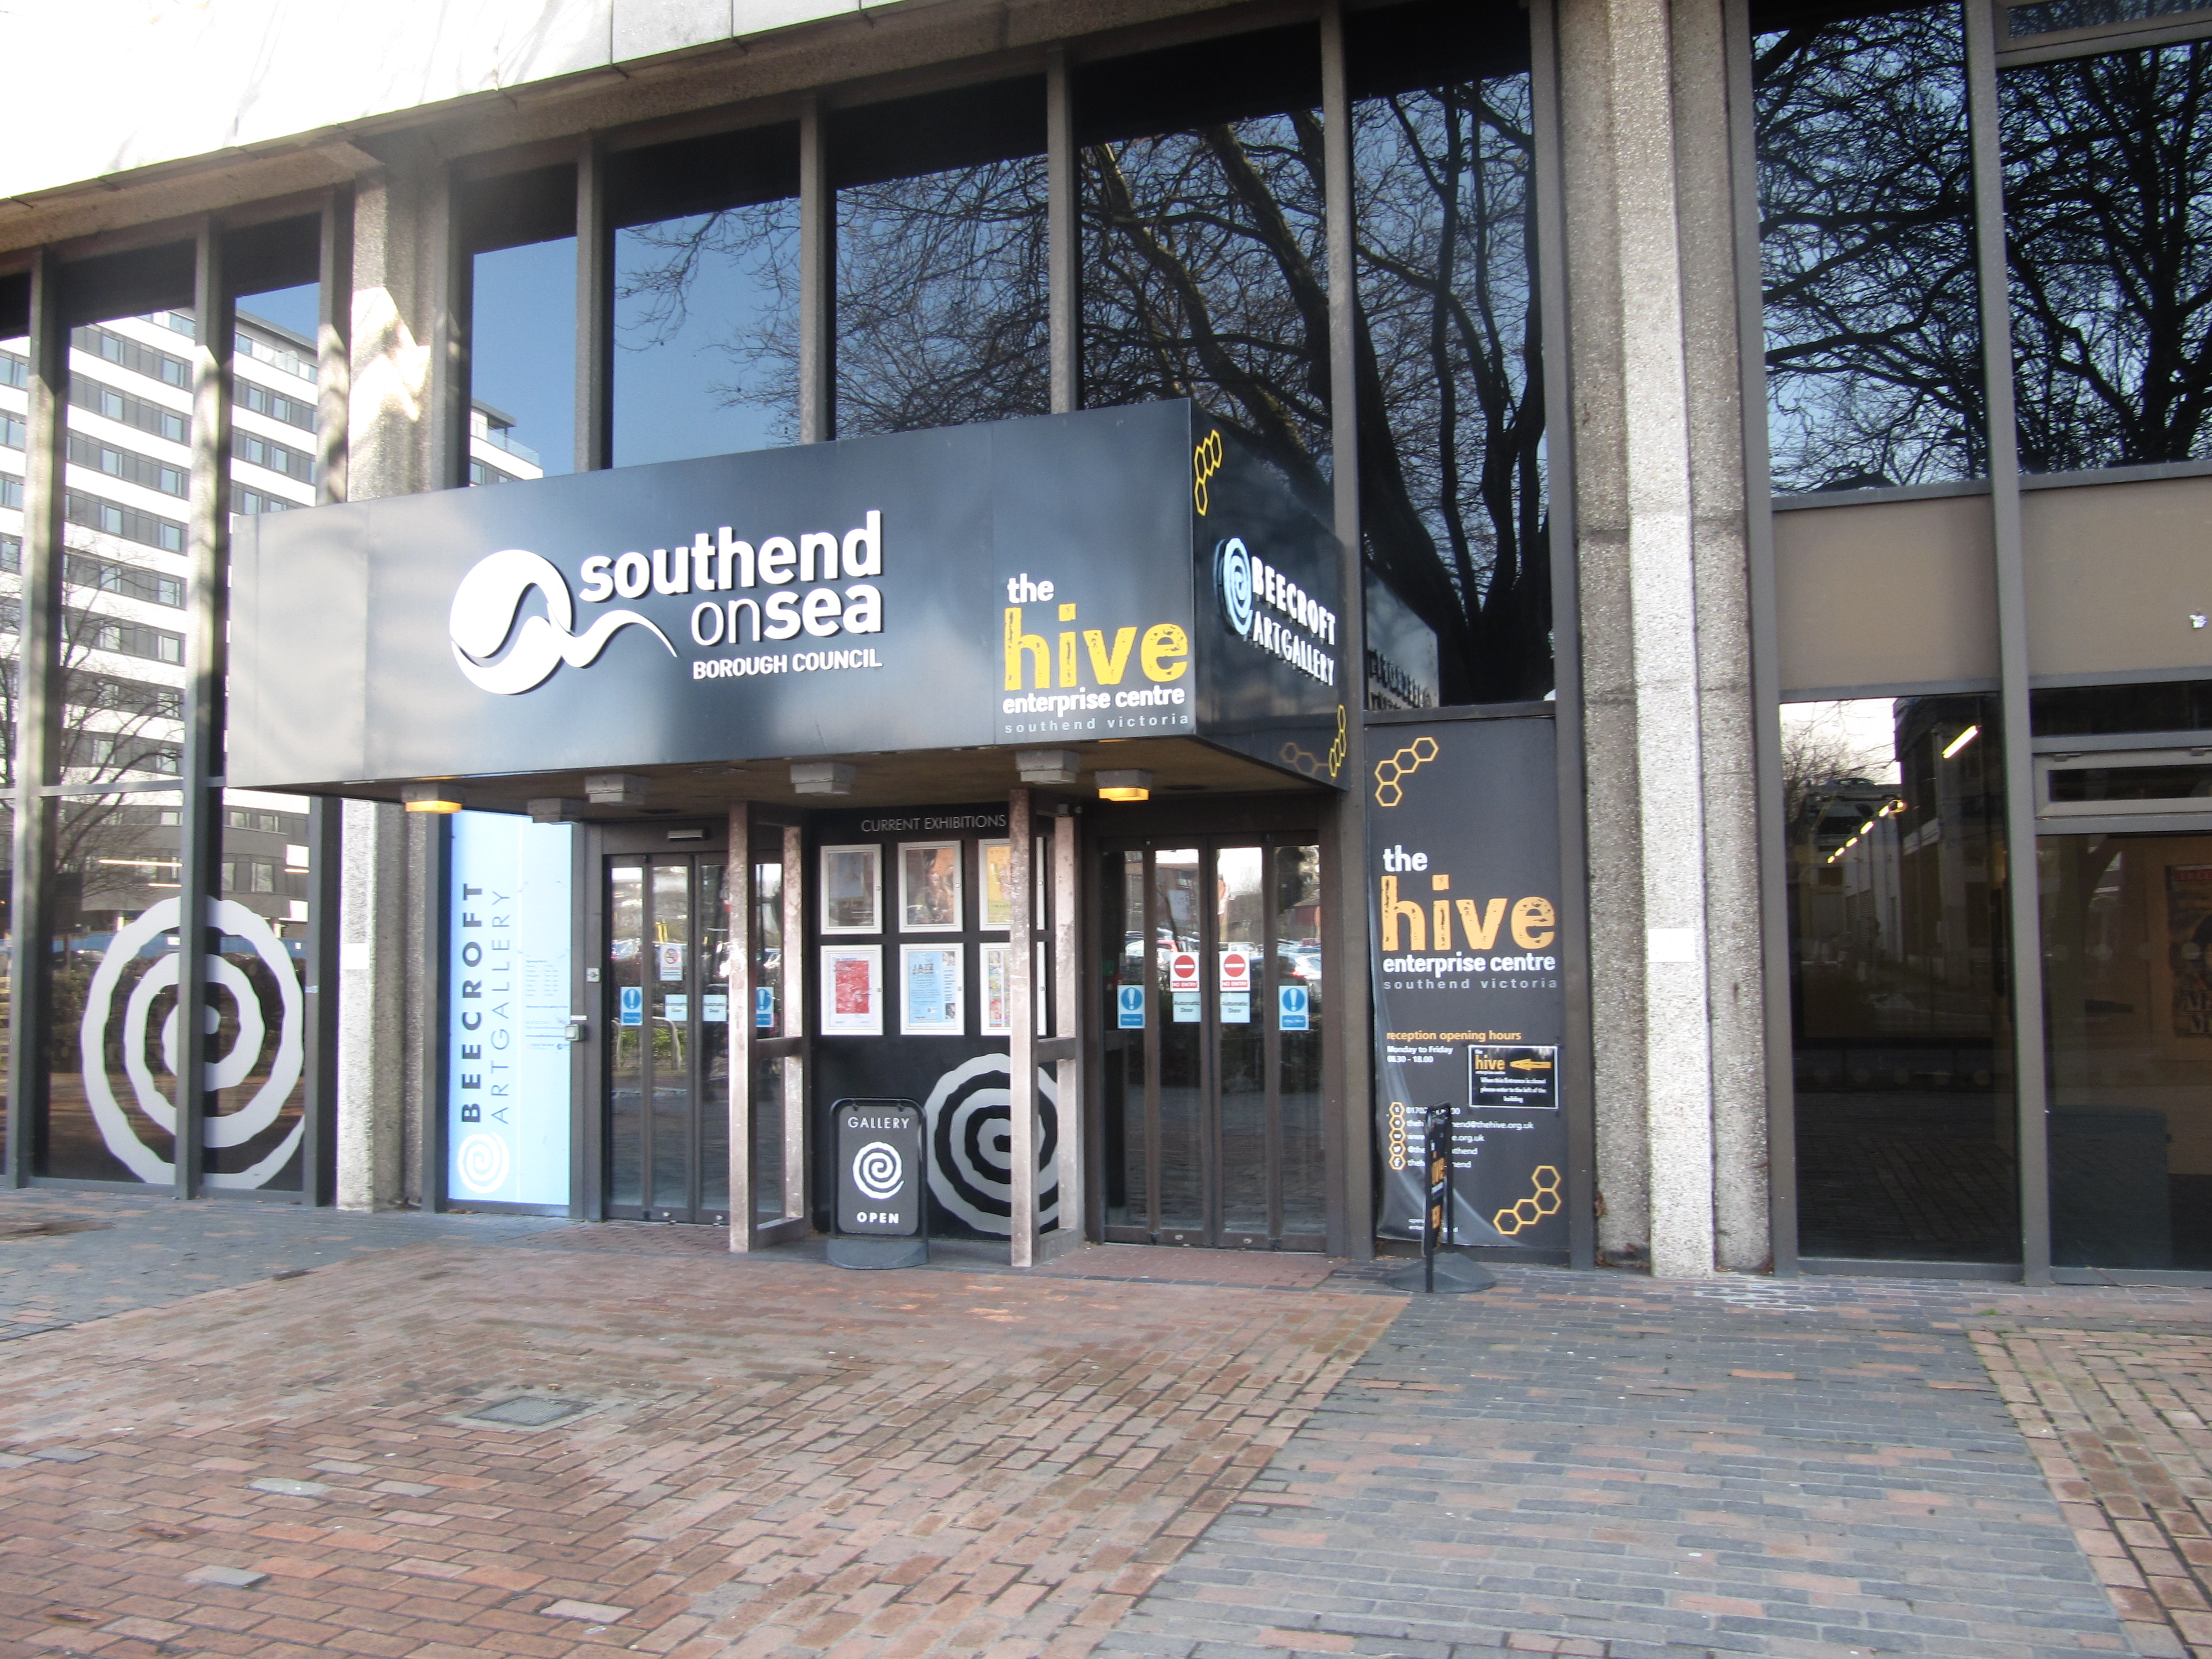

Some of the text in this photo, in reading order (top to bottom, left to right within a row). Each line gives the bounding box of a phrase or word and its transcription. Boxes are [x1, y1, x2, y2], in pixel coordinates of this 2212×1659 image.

[580, 509, 883, 603] southend
[1007, 573, 1054, 603] the
[1251, 556, 1335, 645] BEECROFT
[1004, 603, 1188, 691] hive
[693, 648, 883, 680] BOROUGH COUNCIL
[1003, 685, 1185, 718] enterprise centre
[1005, 714, 1188, 734] southend victoria
[860, 814, 1006, 832] CURRENT EXHIBITIONS
[1383, 844, 1428, 872] the
[1381, 874, 1556, 951] hive
[1383, 951, 1556, 978] enterprise centre
[1383, 977, 1558, 989] southend victoria
[461, 883, 483, 1123] BEECROFT
[1386, 1030, 1522, 1042] reception opening hours
[1386, 1046, 1417, 1054] Monday
[1428, 1046, 1454, 1055] Friday
[1474, 1055, 1505, 1070] hive
[848, 1117, 910, 1129] GALLERY
[857, 1212, 900, 1224] OPEN
